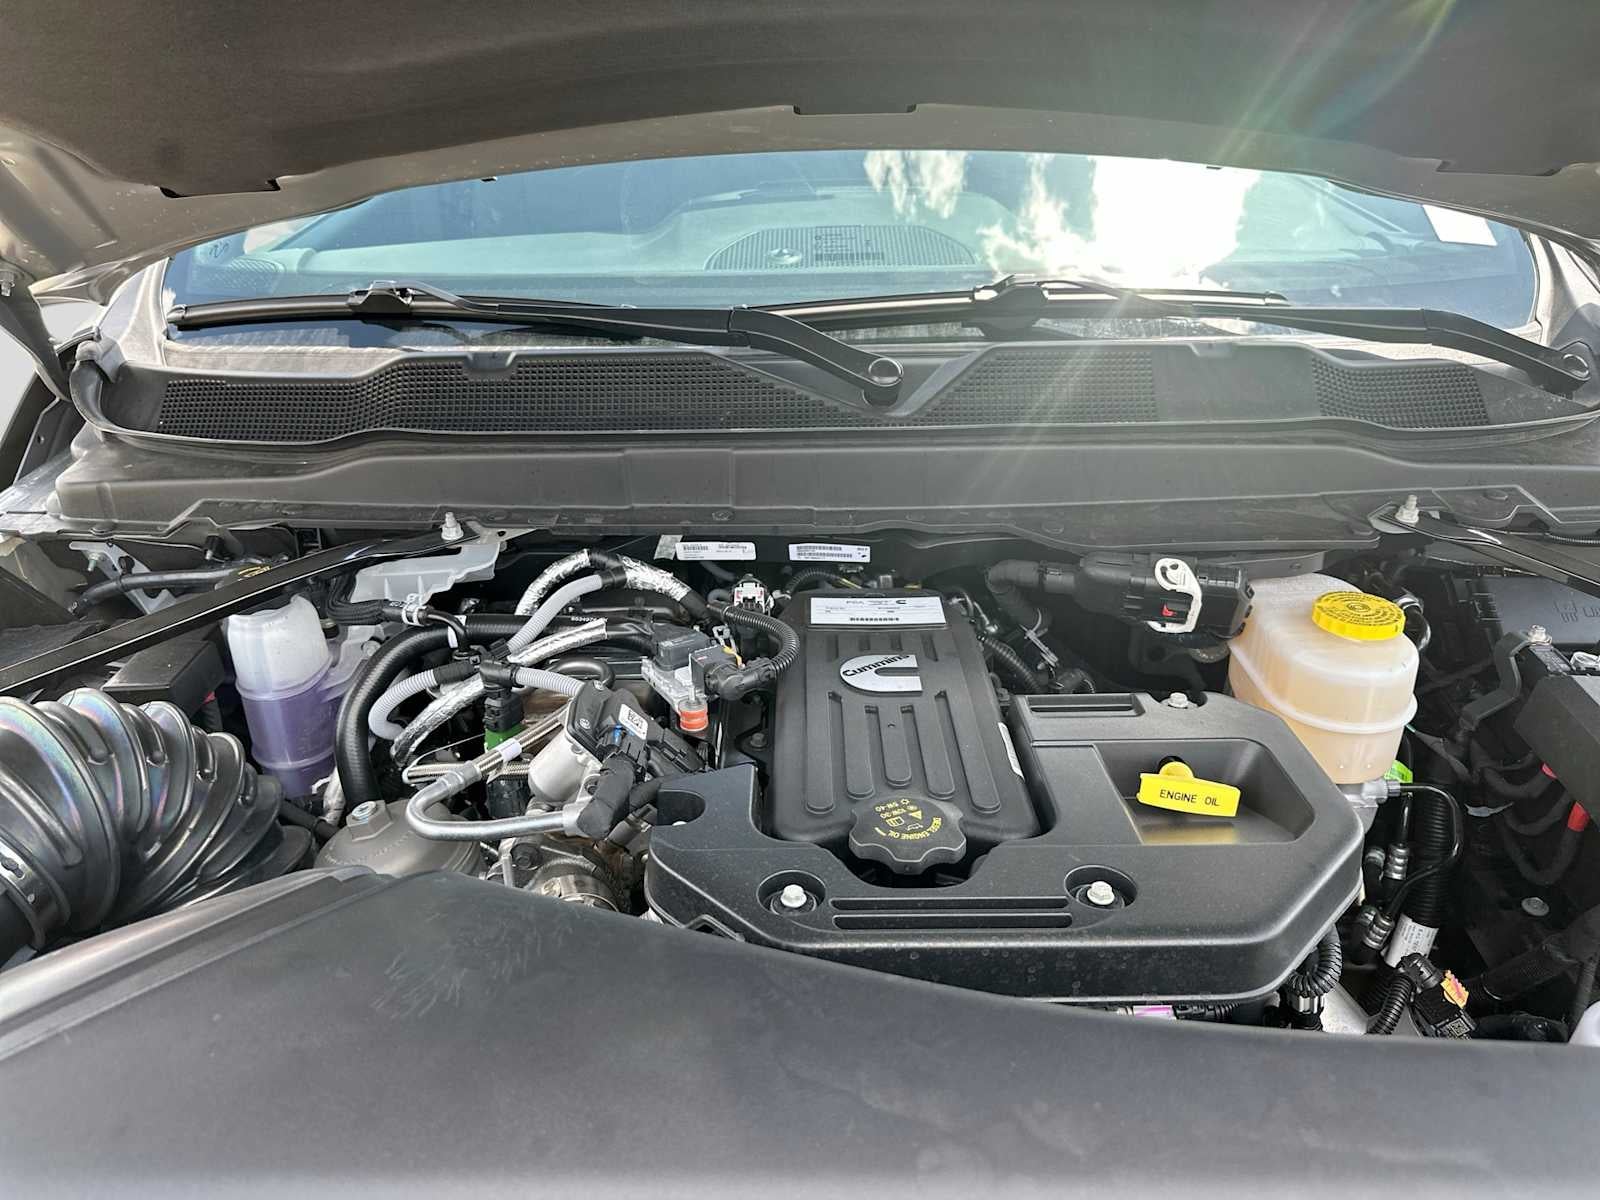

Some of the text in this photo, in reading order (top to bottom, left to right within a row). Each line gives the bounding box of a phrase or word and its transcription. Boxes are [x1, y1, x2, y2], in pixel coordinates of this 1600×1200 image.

[1160, 789, 1220, 807] ENGINE OIL
[888, 829, 900, 839] OIL
[900, 830, 930, 840] ENGINE
